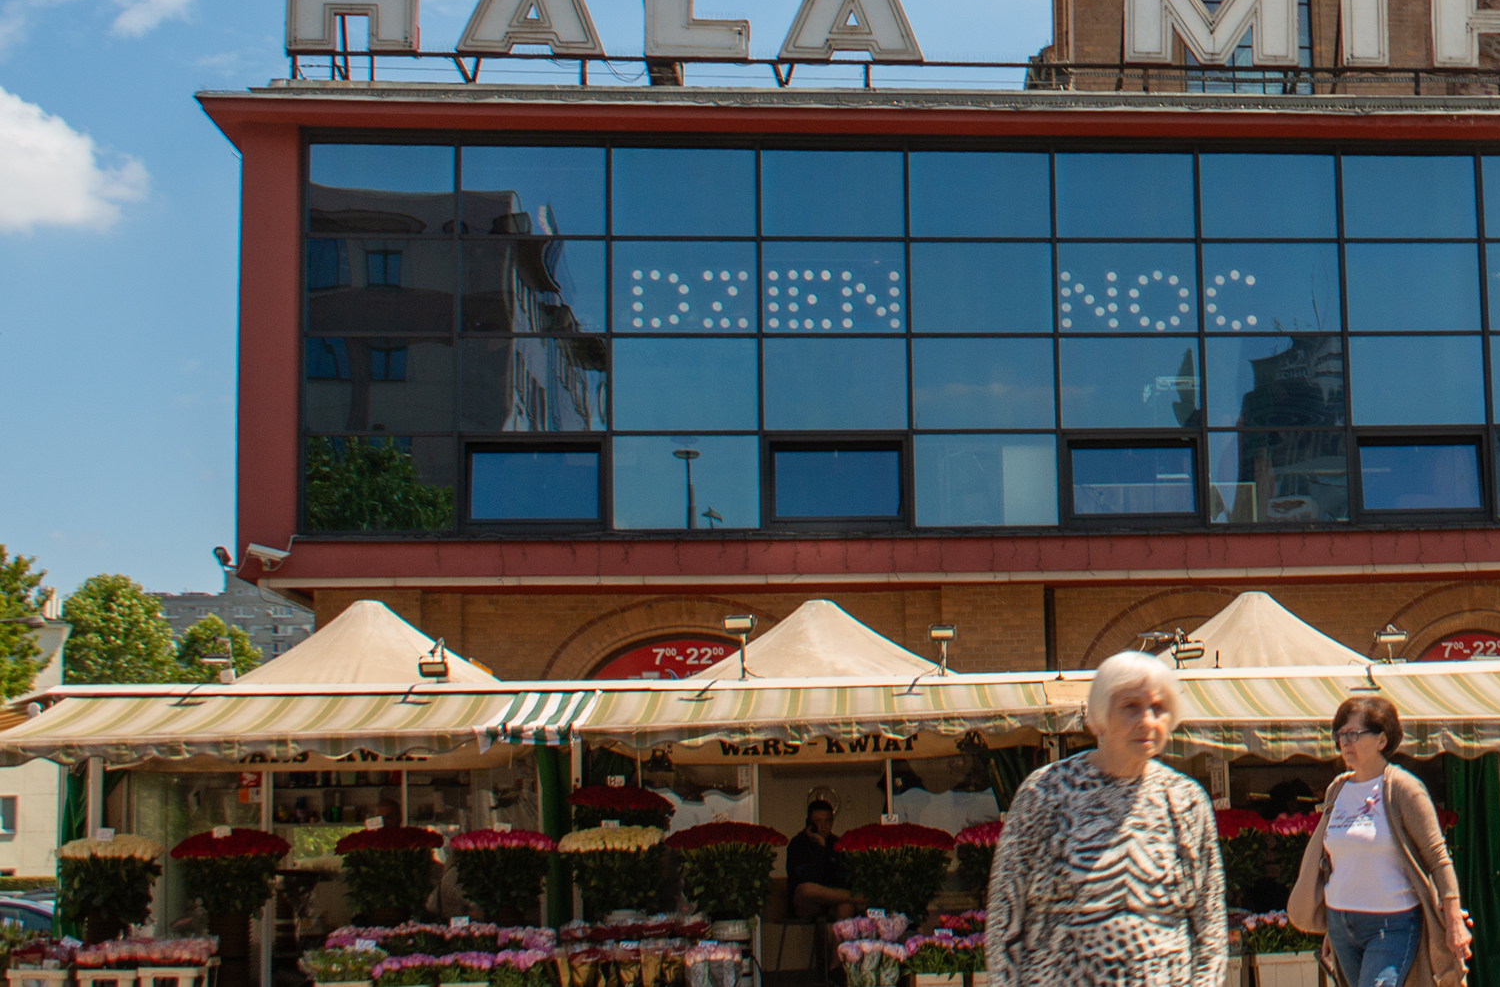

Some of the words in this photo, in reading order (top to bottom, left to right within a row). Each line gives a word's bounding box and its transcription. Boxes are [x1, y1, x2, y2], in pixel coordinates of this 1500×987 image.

[1060, 269, 1257, 331] NOC
[719, 738, 800, 756] WARS
[825, 733, 918, 754] KWIAT
